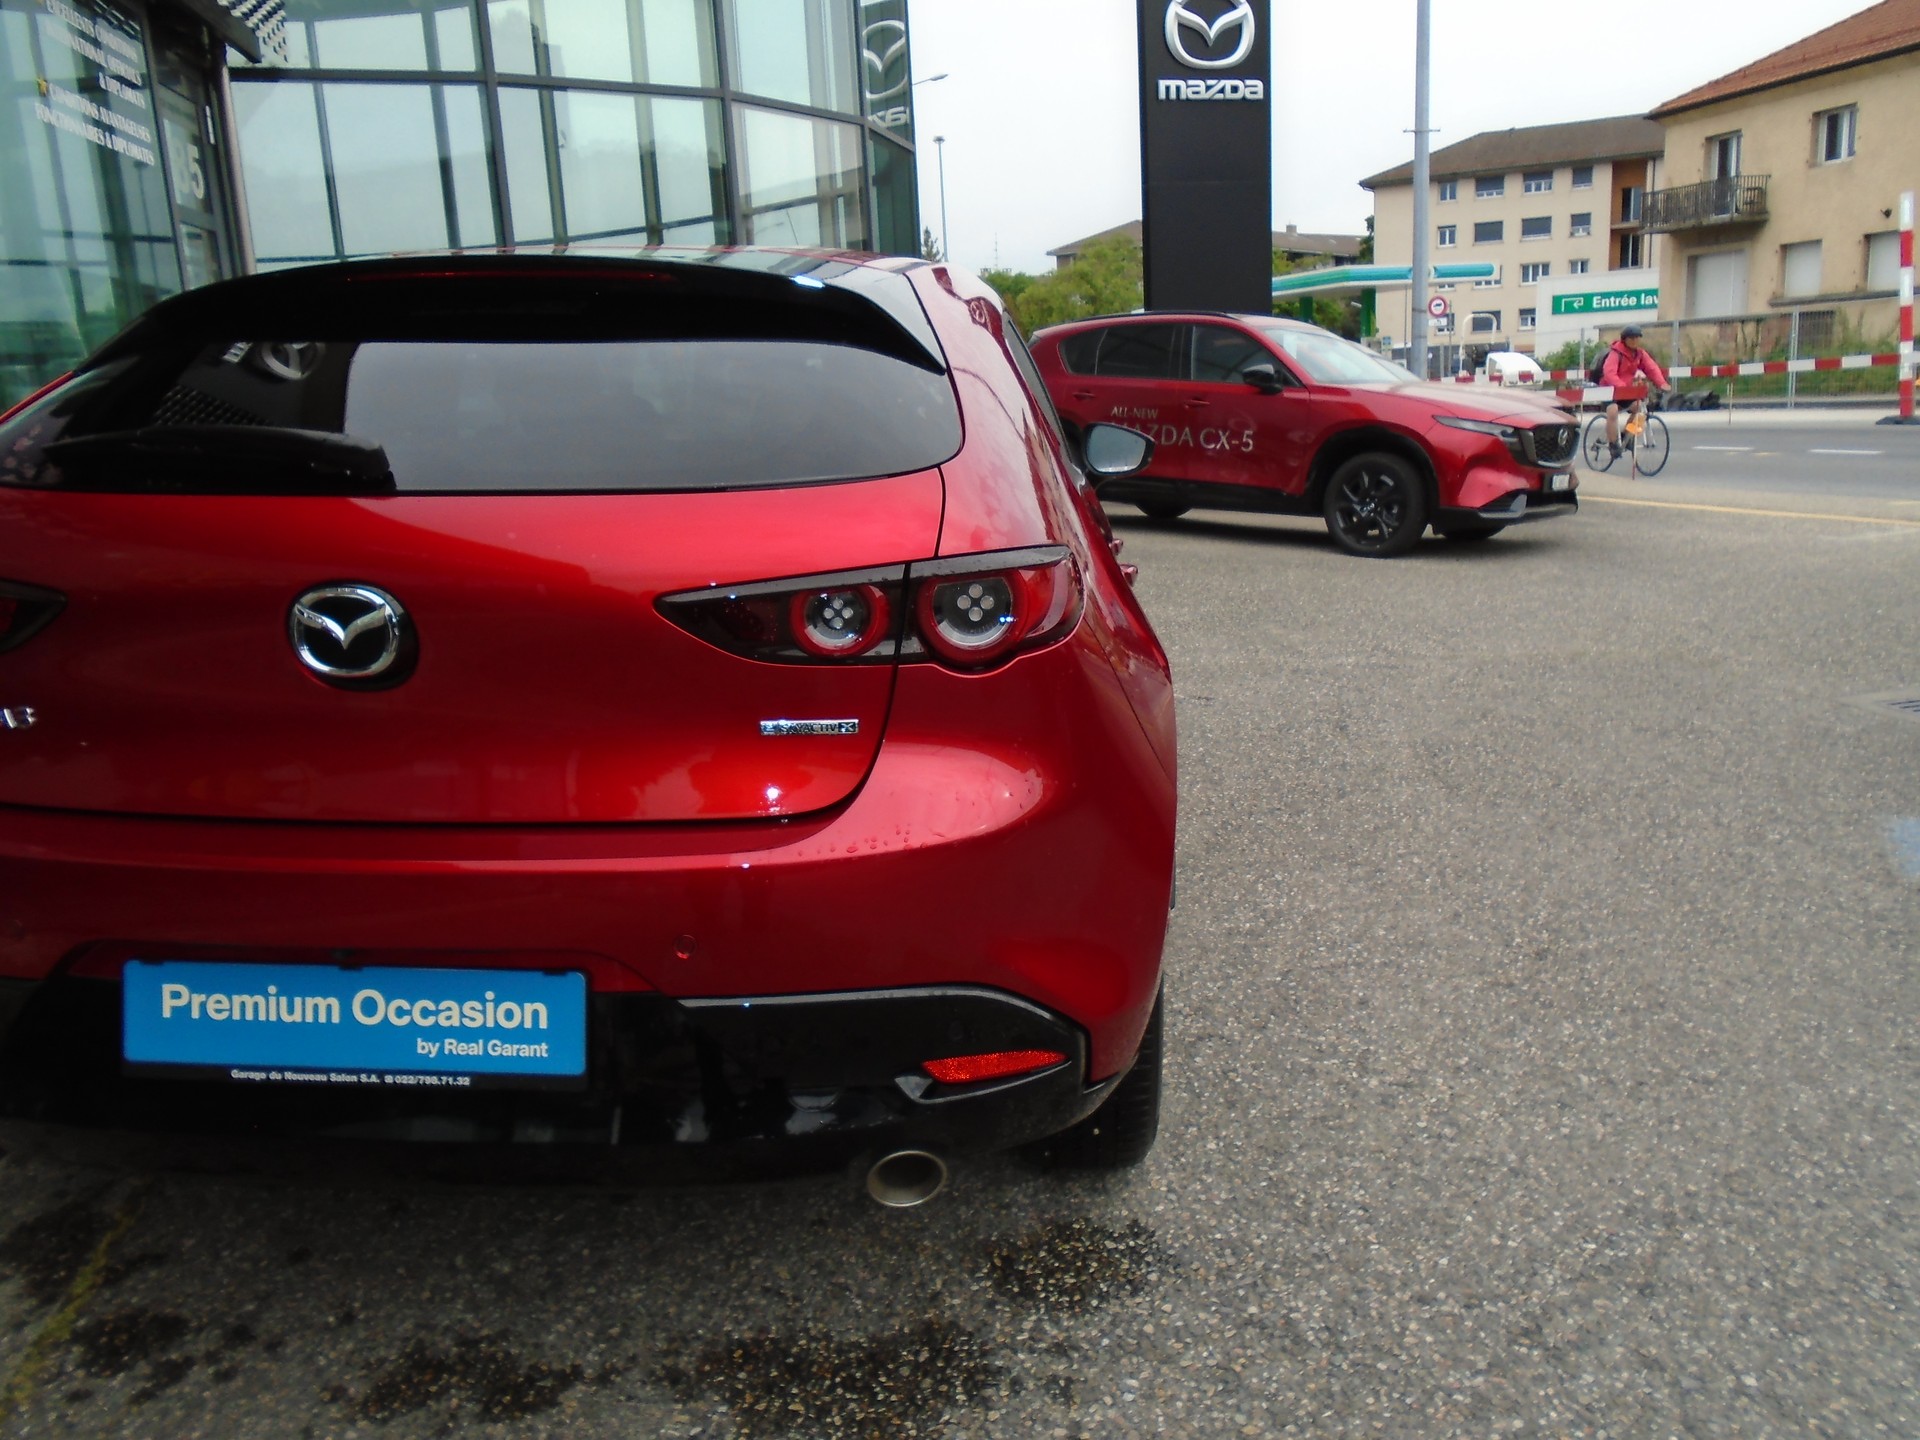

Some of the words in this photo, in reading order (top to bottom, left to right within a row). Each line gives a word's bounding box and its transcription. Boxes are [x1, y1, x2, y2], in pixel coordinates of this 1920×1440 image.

[1592, 293, 1638, 309] Entrée
[1110, 405, 1159, 420] ALL-NEW
[1112, 422, 1194, 447] ZDA
[1199, 427, 1254, 452] CX-5
[161, 983, 341, 1025] Premium
[351, 989, 549, 1031] Occasion
[416, 1037, 440, 1058] by
[444, 1038, 484, 1057] Real
[486, 1040, 549, 1059] Garant
[231, 1069, 267, 1081] Garage
[269, 1071, 282, 1080] du
[284, 1071, 328, 1082] Nouveau
[360, 1074, 380, 1083] S.A.
